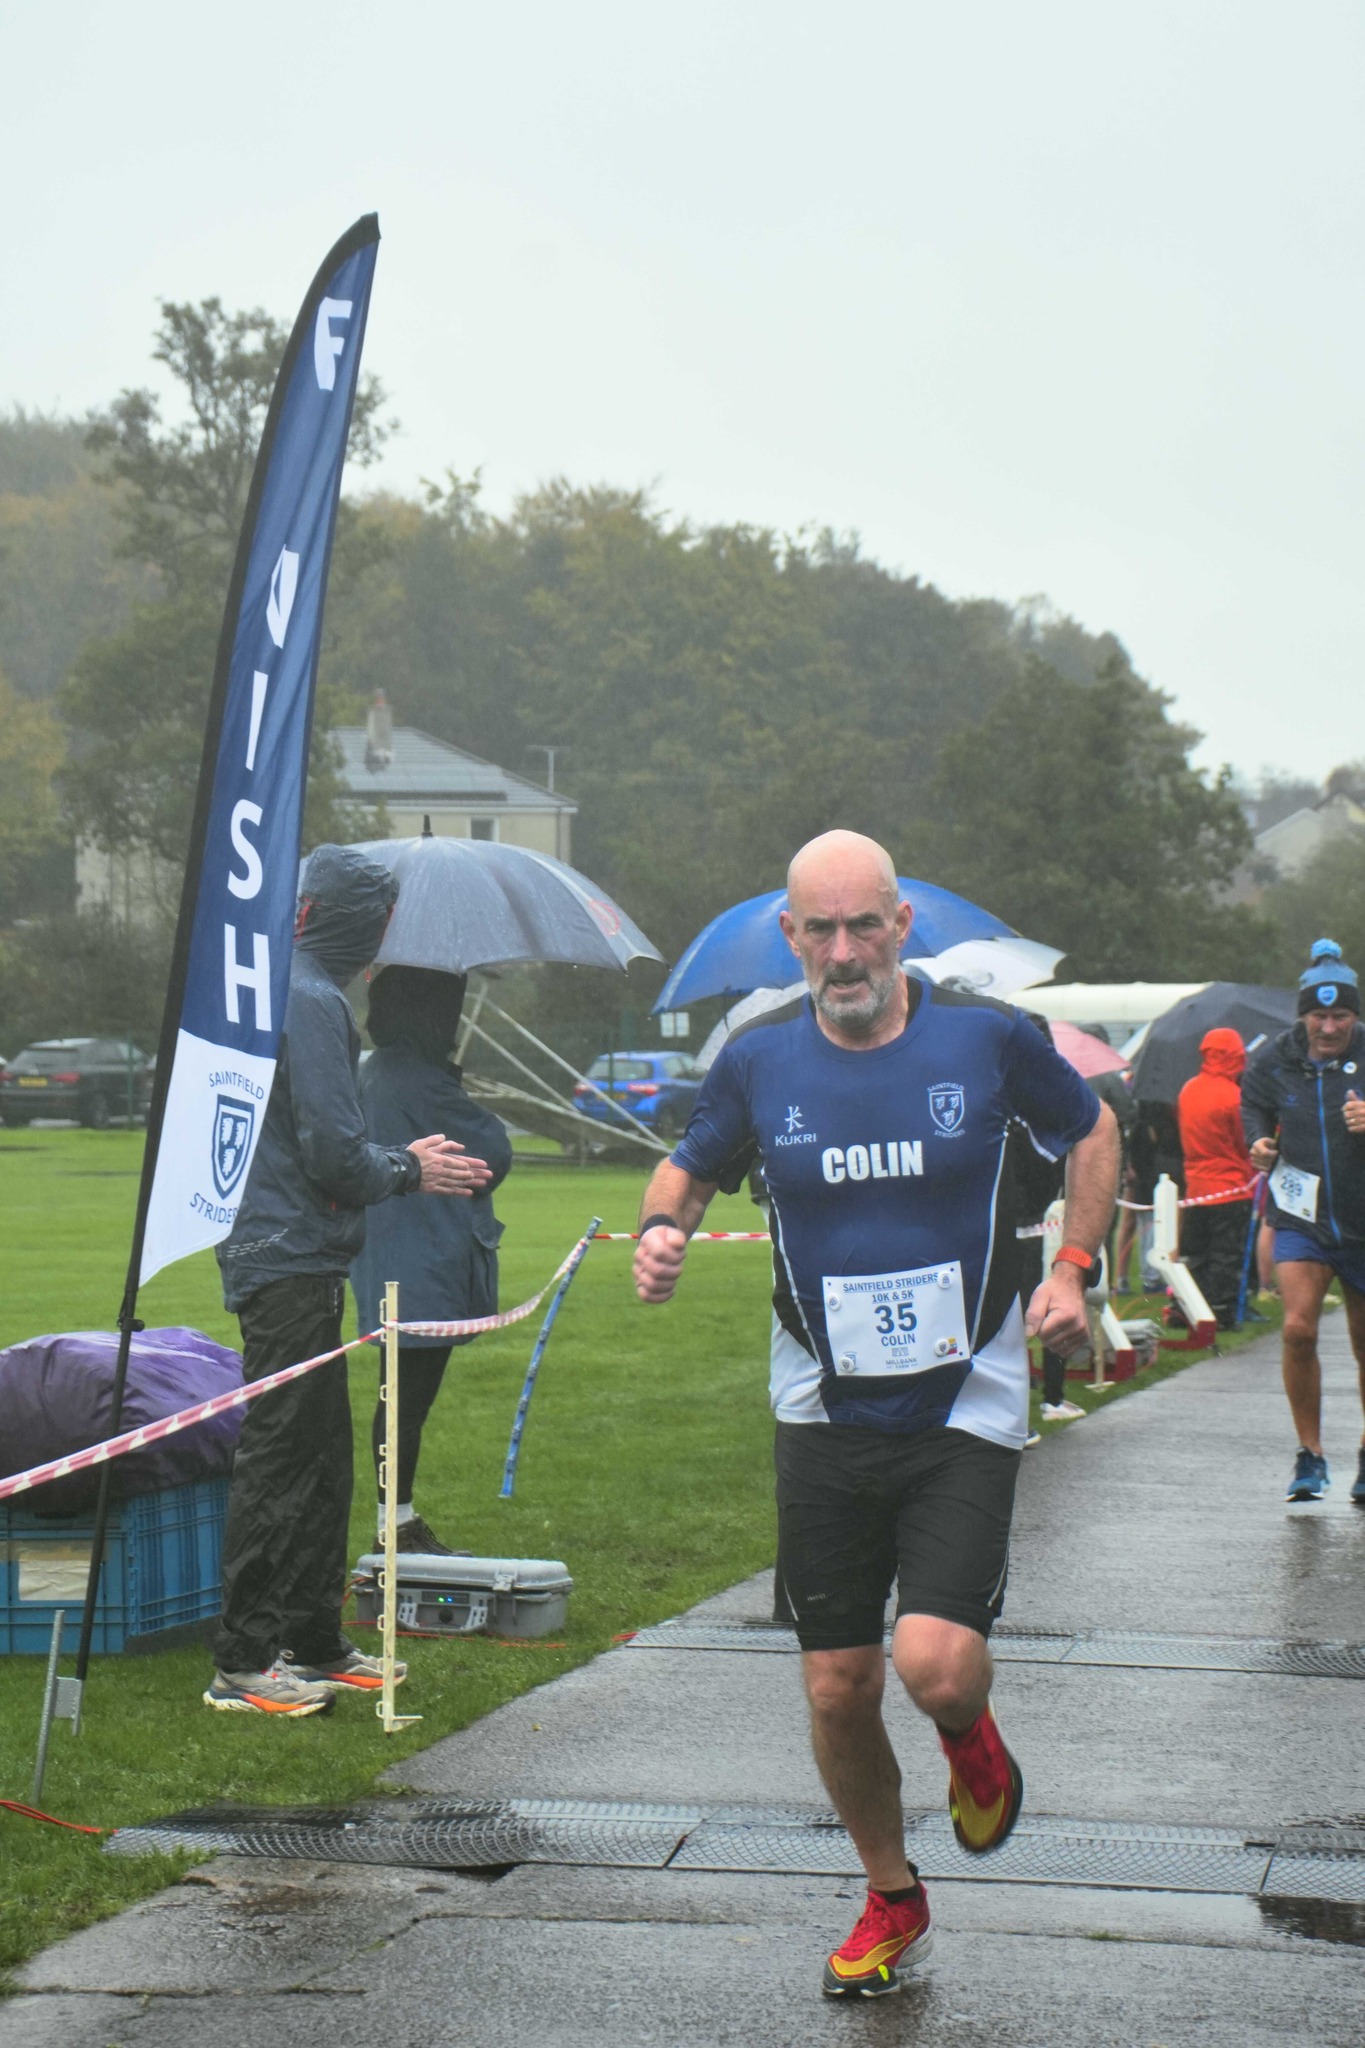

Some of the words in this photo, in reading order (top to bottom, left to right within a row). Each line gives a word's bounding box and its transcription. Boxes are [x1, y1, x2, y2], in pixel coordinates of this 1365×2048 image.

[223, 296, 353, 1032] FNISH
[208, 1070, 265, 1100] SAINTFIELD
[926, 1082, 964, 1092] SAINTFIELD
[775, 1133, 817, 1146] KUKRI
[821, 1140, 924, 1183] COLIN
[843, 1278, 893, 1293] SAINTFIELD
[895, 1272, 938, 1288] STRIDERS
[872, 1293, 889, 1303] 10K
[892, 1291, 899, 1301] &
[902, 1289, 914, 1299] 5K
[874, 1302, 917, 1335] 35
[881, 1333, 916, 1347] COLIN
